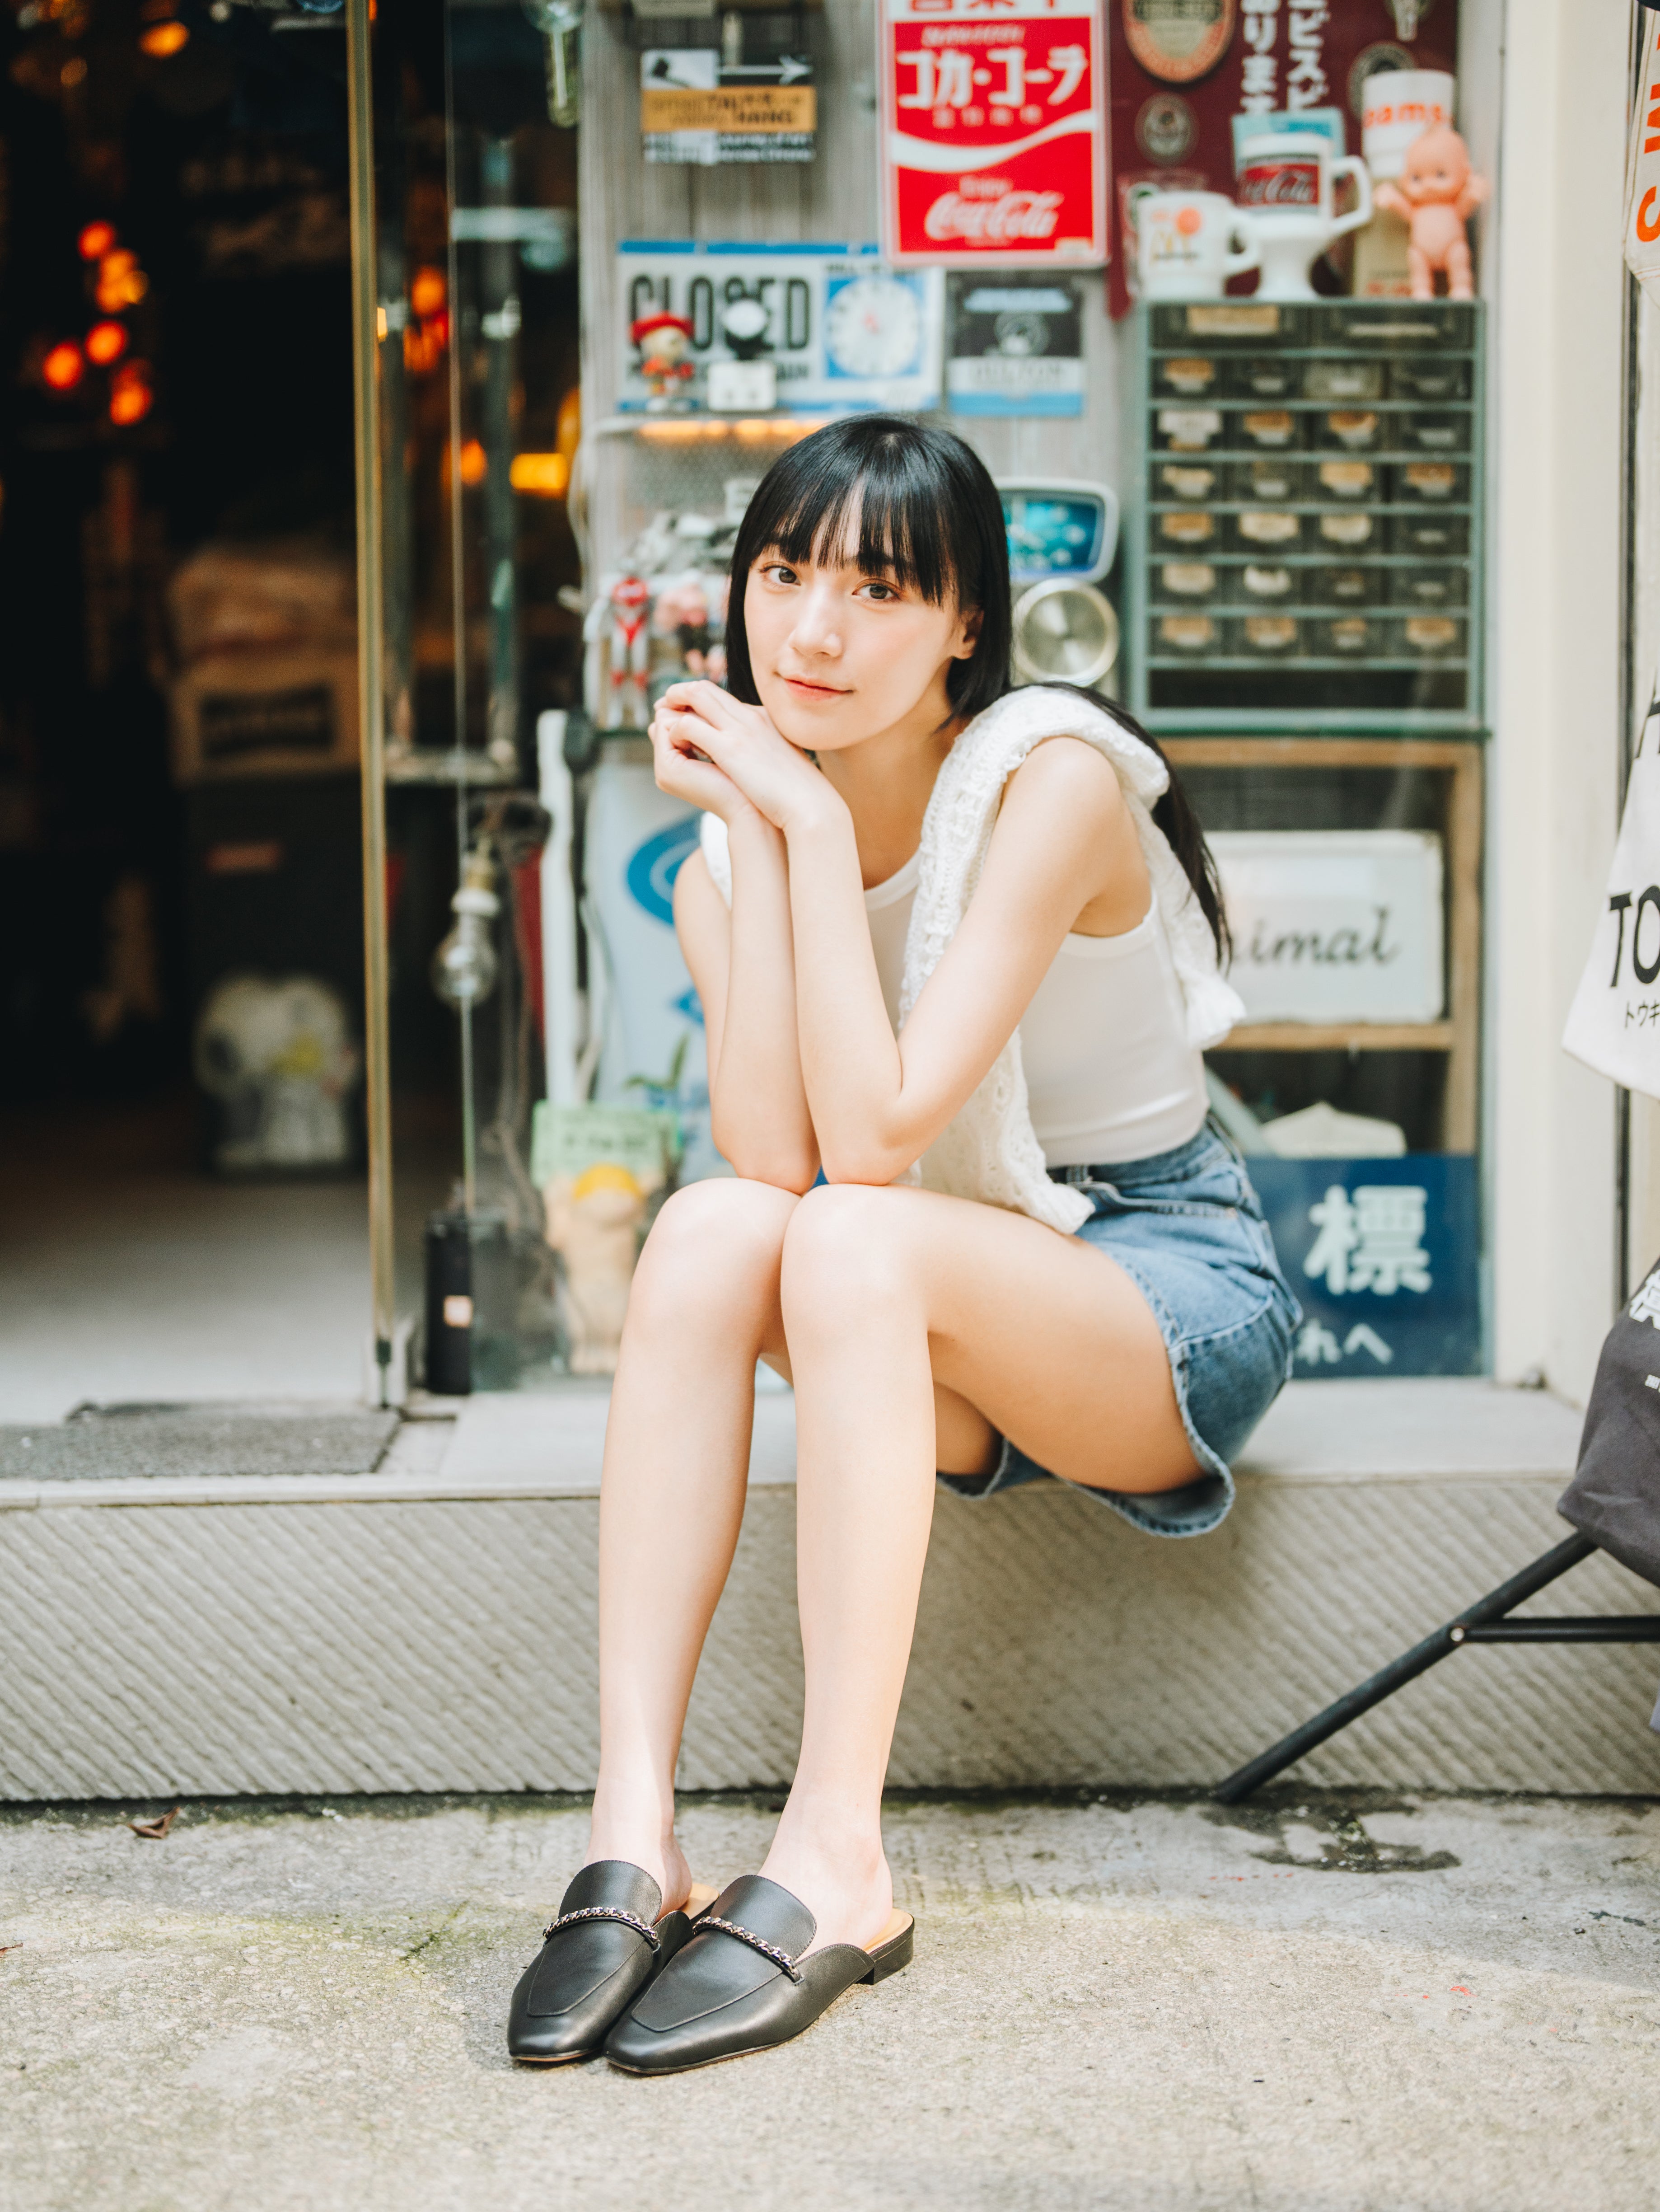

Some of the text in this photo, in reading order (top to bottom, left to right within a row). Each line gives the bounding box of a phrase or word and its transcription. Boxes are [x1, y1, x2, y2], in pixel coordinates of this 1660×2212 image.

[896, 44, 1089, 109] コカ・コーラ
[1286, 0, 1331, 111] ビスビ
[1233, 904, 1404, 968] imal
[1304, 1184, 1433, 1296] 標
